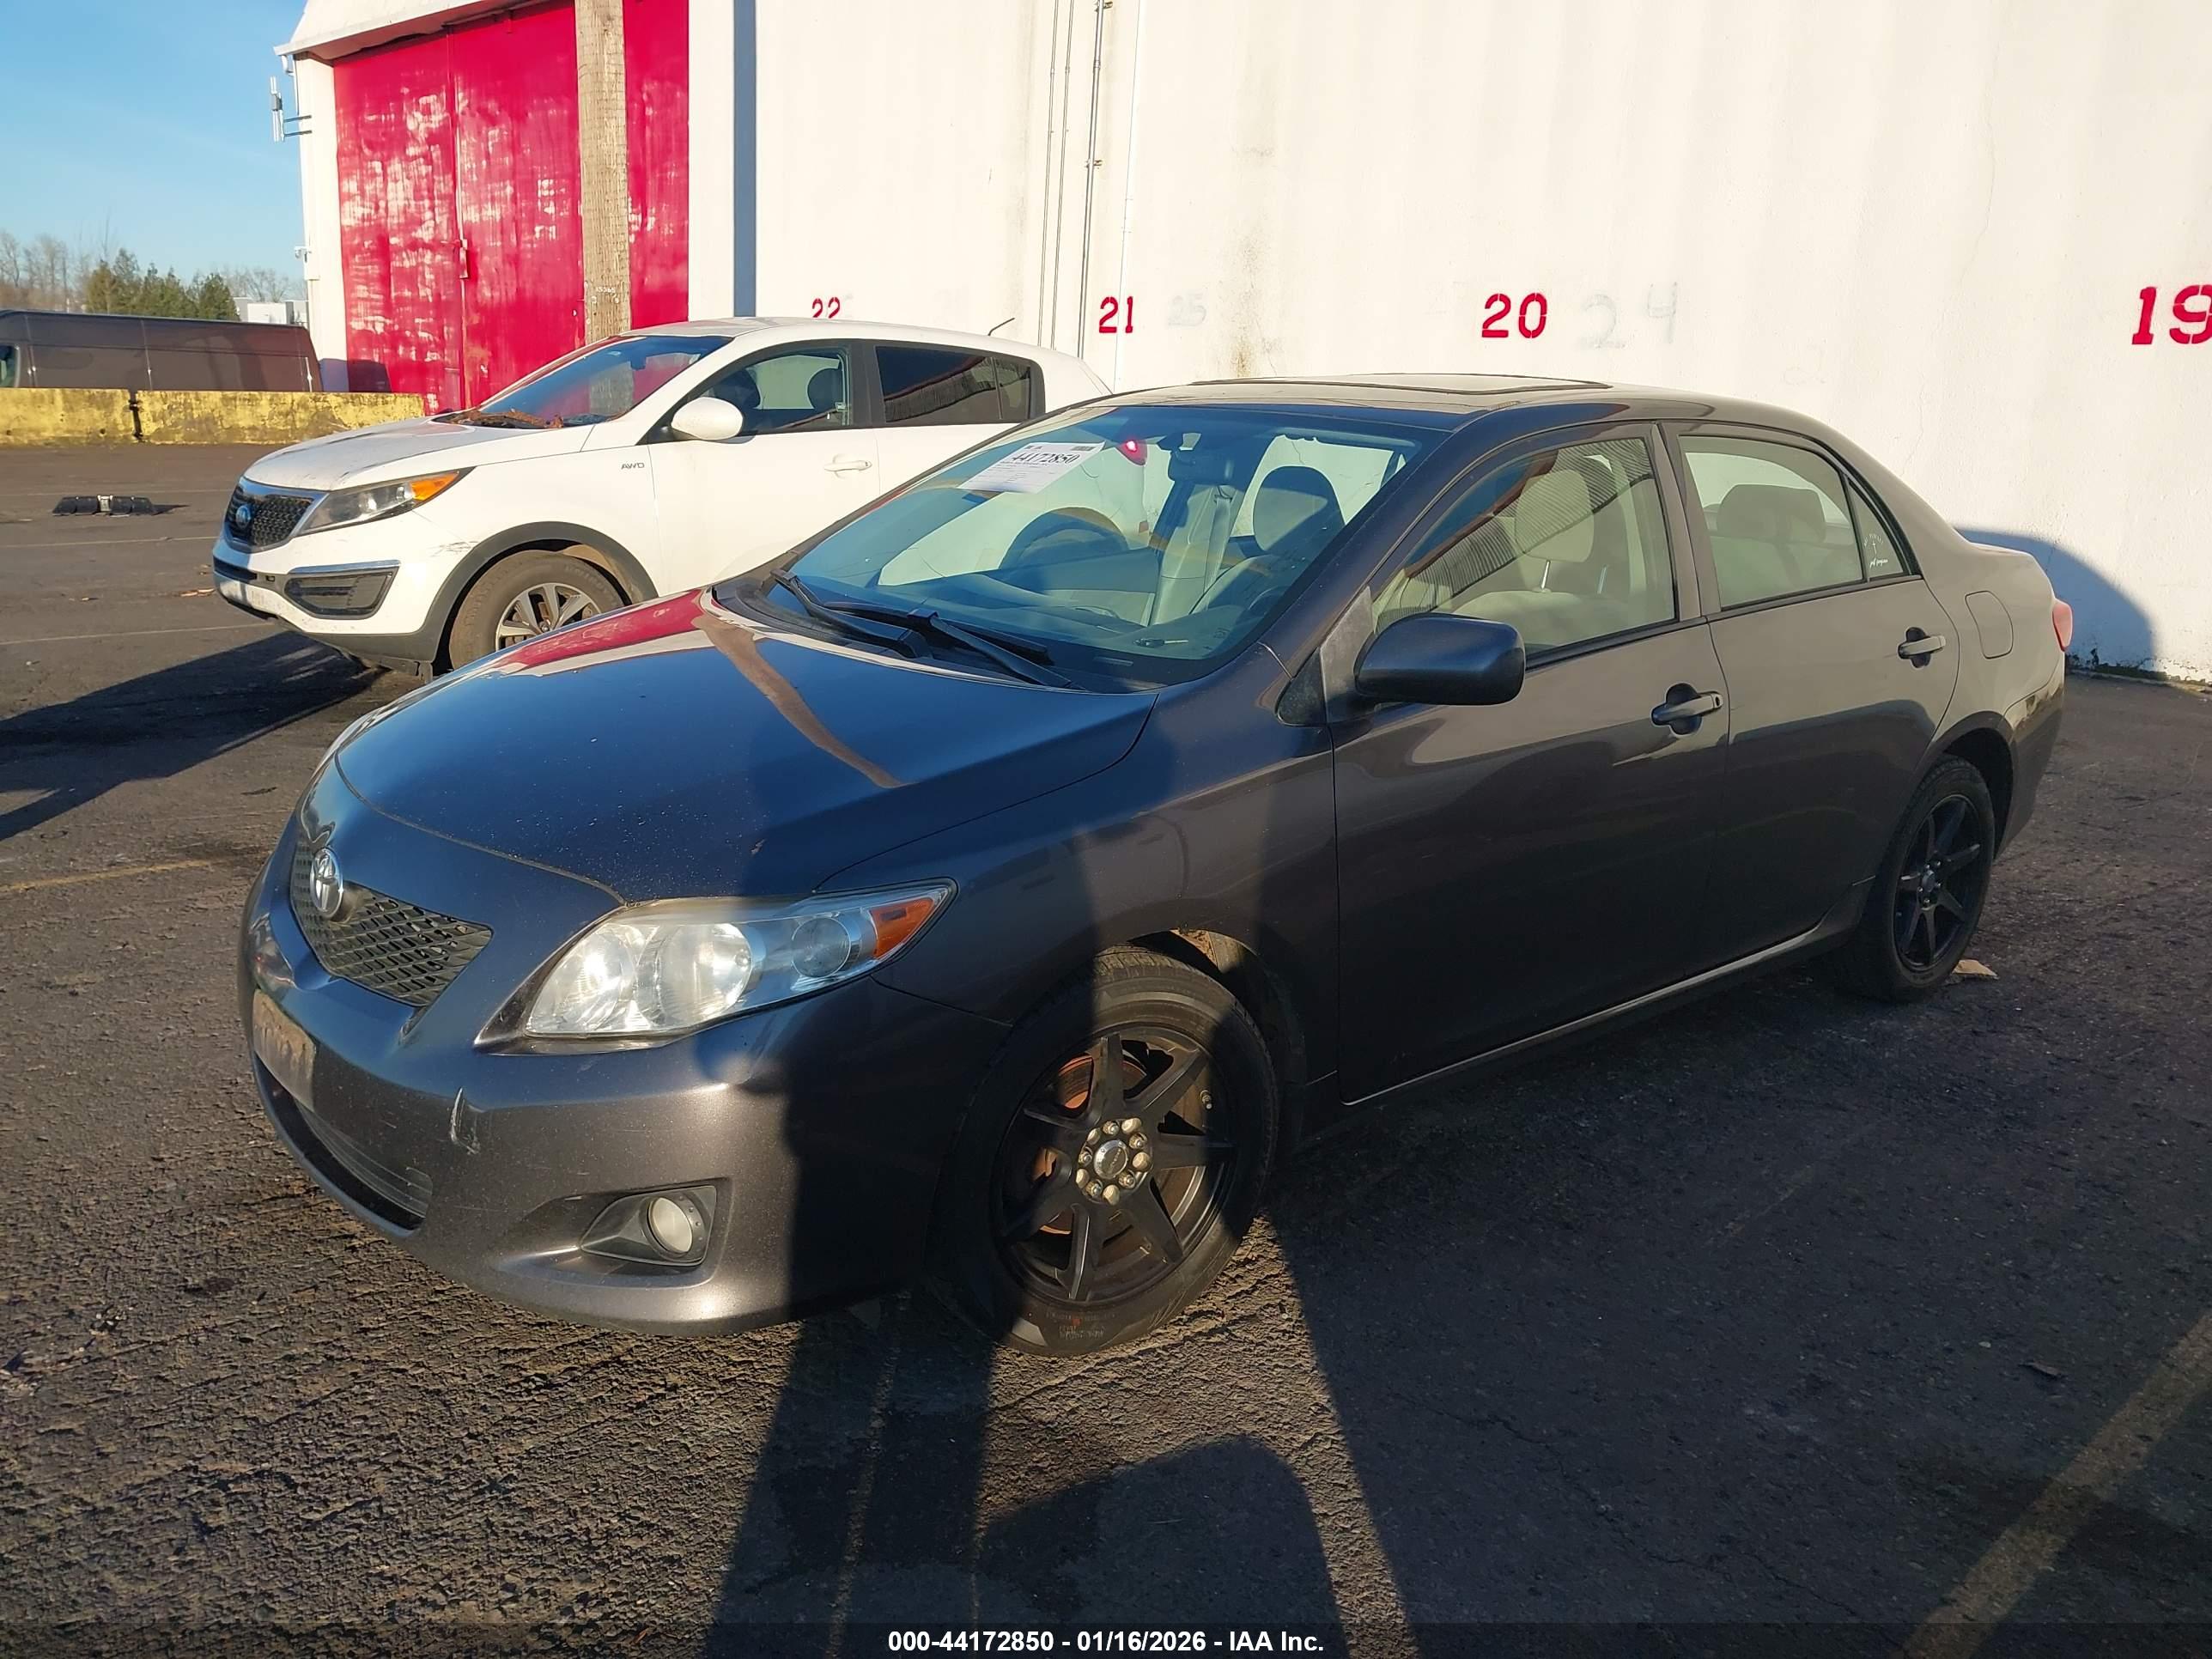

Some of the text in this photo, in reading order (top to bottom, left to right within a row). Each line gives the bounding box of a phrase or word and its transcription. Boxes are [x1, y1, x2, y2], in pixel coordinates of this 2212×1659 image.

[811, 296, 841, 319] 22
[1099, 295, 1133, 334] 21
[1481, 292, 1548, 339] 20
[2131, 284, 2212, 345] 19
